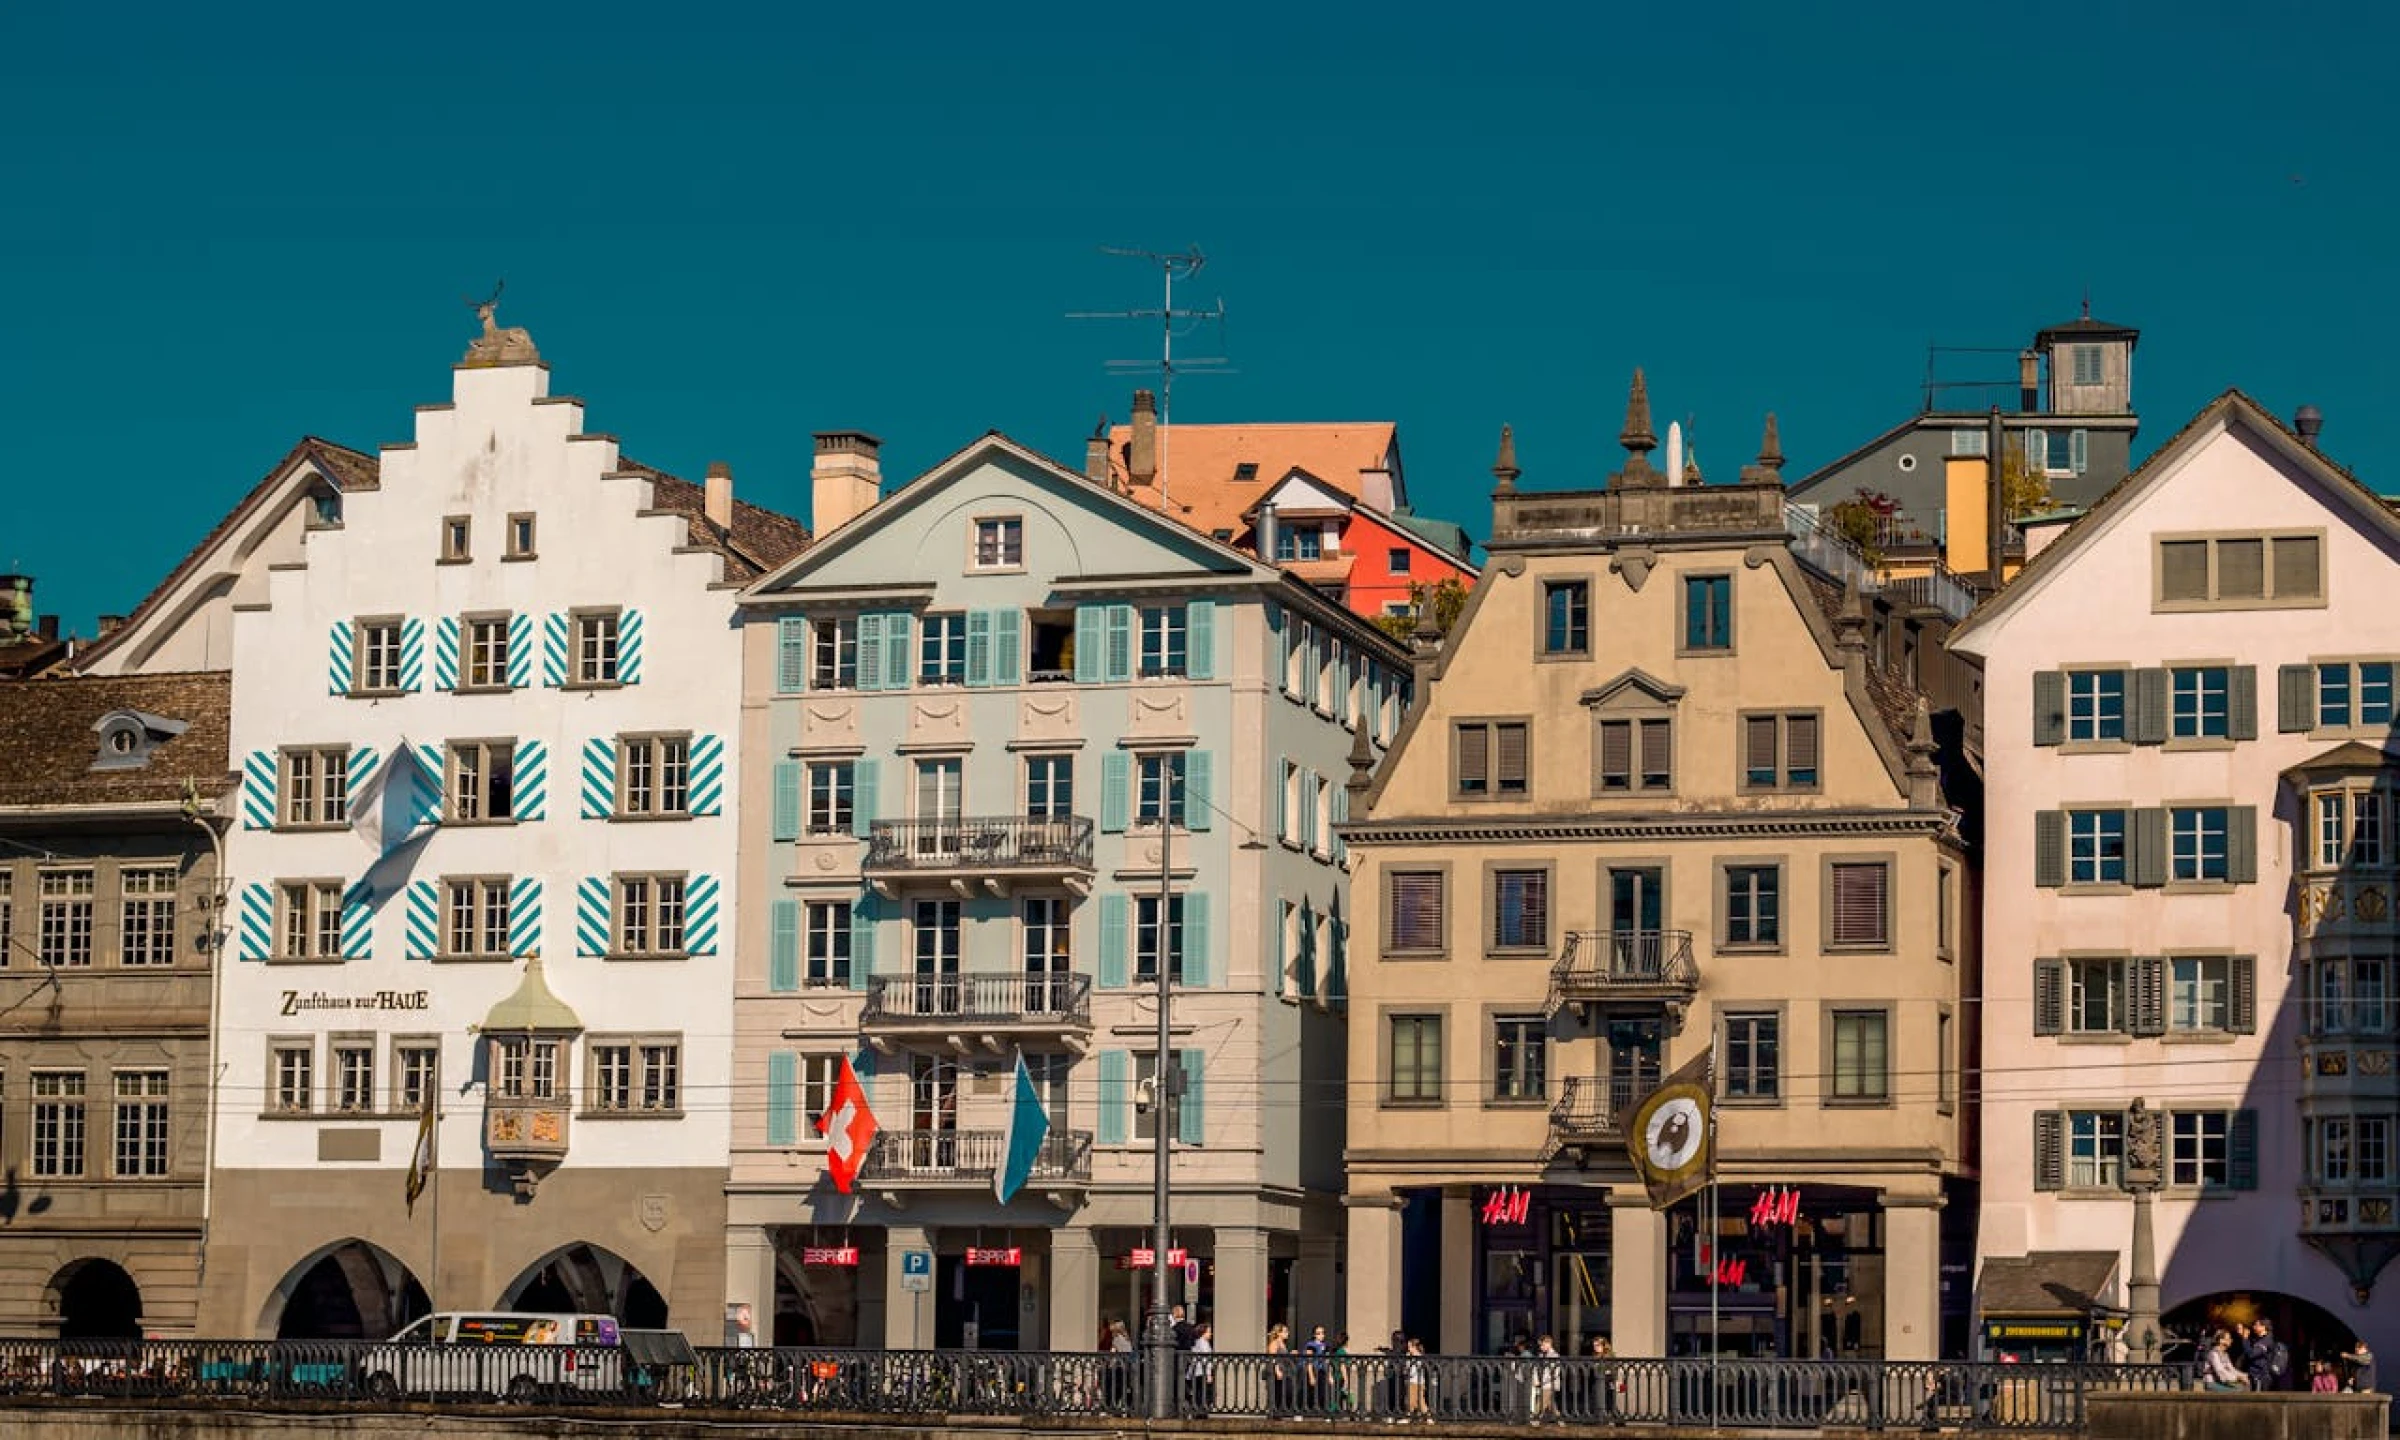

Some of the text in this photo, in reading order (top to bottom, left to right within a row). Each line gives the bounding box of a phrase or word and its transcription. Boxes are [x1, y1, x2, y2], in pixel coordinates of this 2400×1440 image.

[355, 997, 377, 1010] zur
[1482, 1190, 1531, 1225] H&M
[1750, 1190, 1800, 1225] H&M
[804, 1248, 855, 1264] ESPRIT
[911, 1255, 923, 1272] P
[967, 1248, 1018, 1265] ESPRIT
